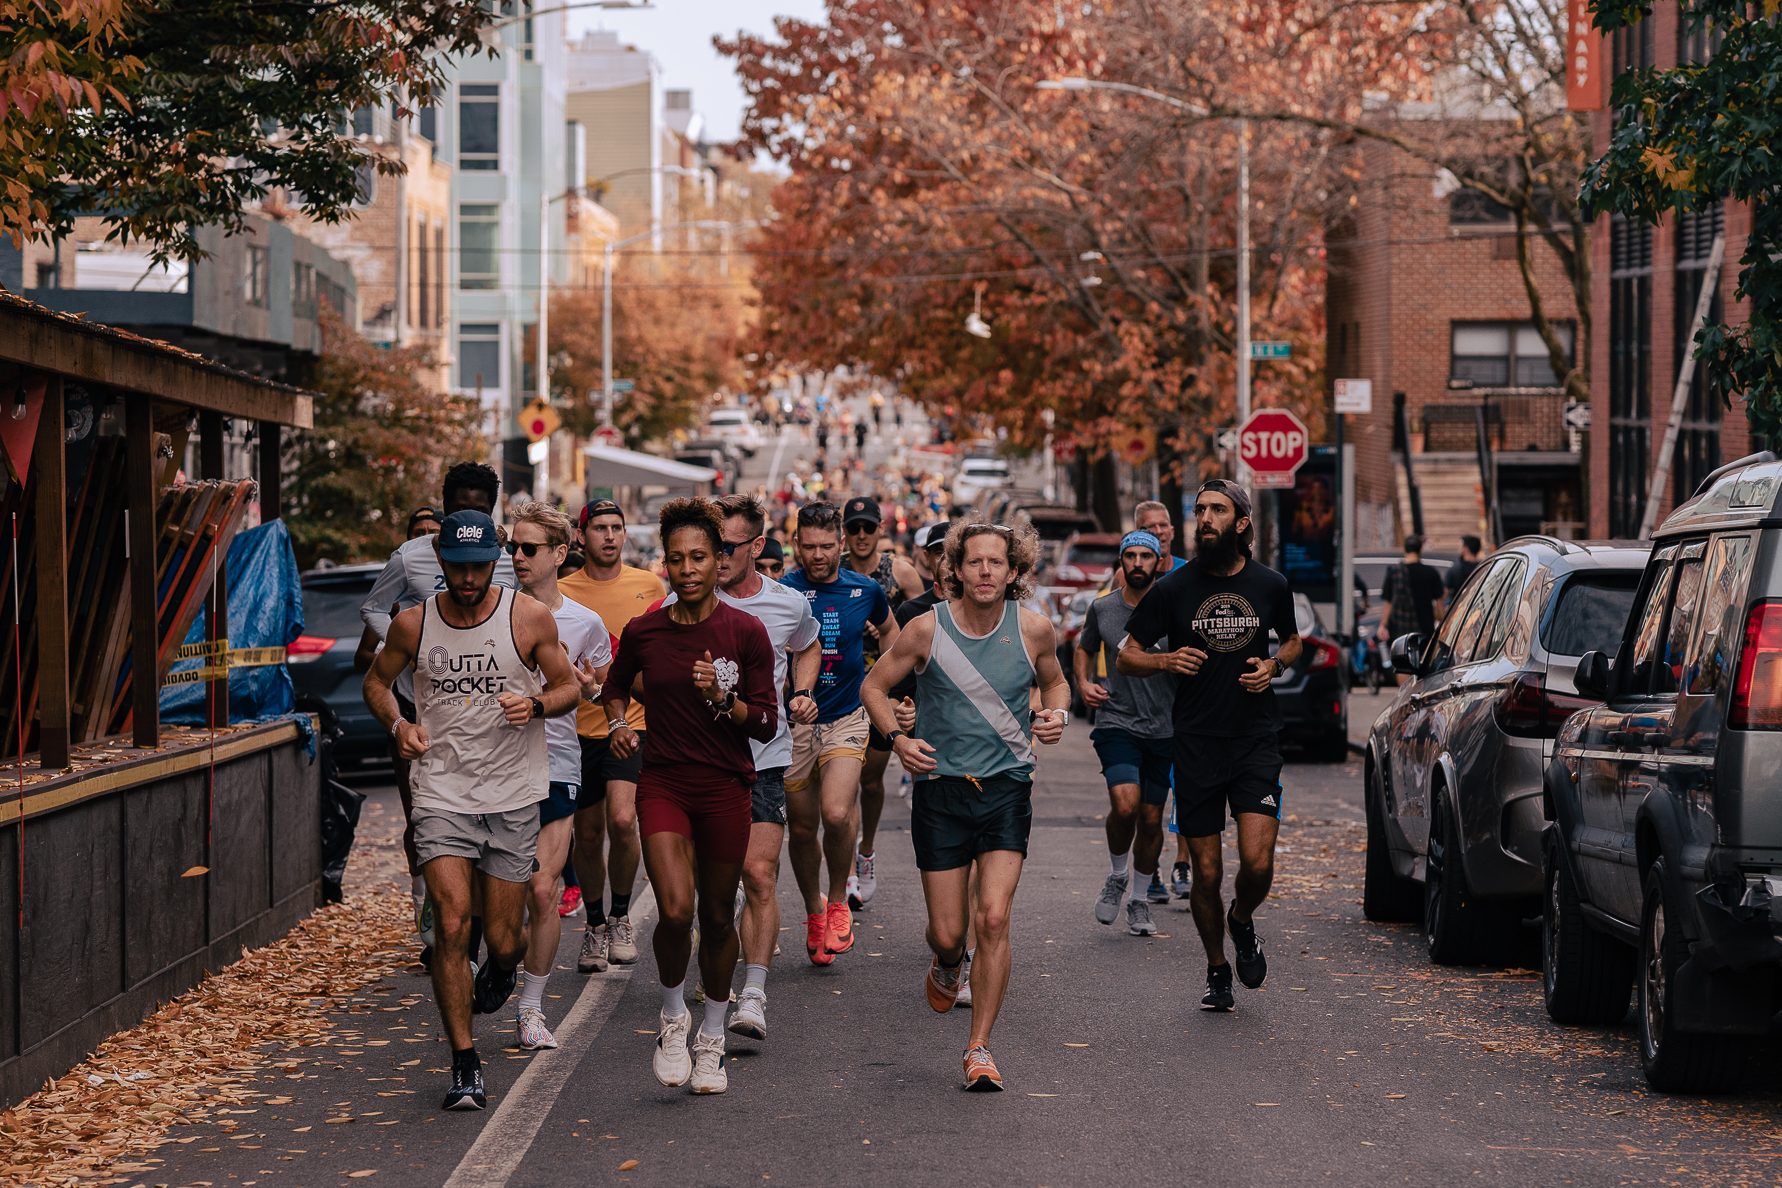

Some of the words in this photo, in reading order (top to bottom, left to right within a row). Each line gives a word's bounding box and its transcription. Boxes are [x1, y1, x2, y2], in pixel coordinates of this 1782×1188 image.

[1242, 431, 1303, 459] STOP
[850, 589, 862, 598] NB
[1192, 617, 1259, 630] PITTSBURGH
[428, 646, 499, 674] OUTTA
[430, 676, 507, 695] POCKET
[437, 699, 463, 707] TRACK
[473, 698, 496, 707] CLUB
